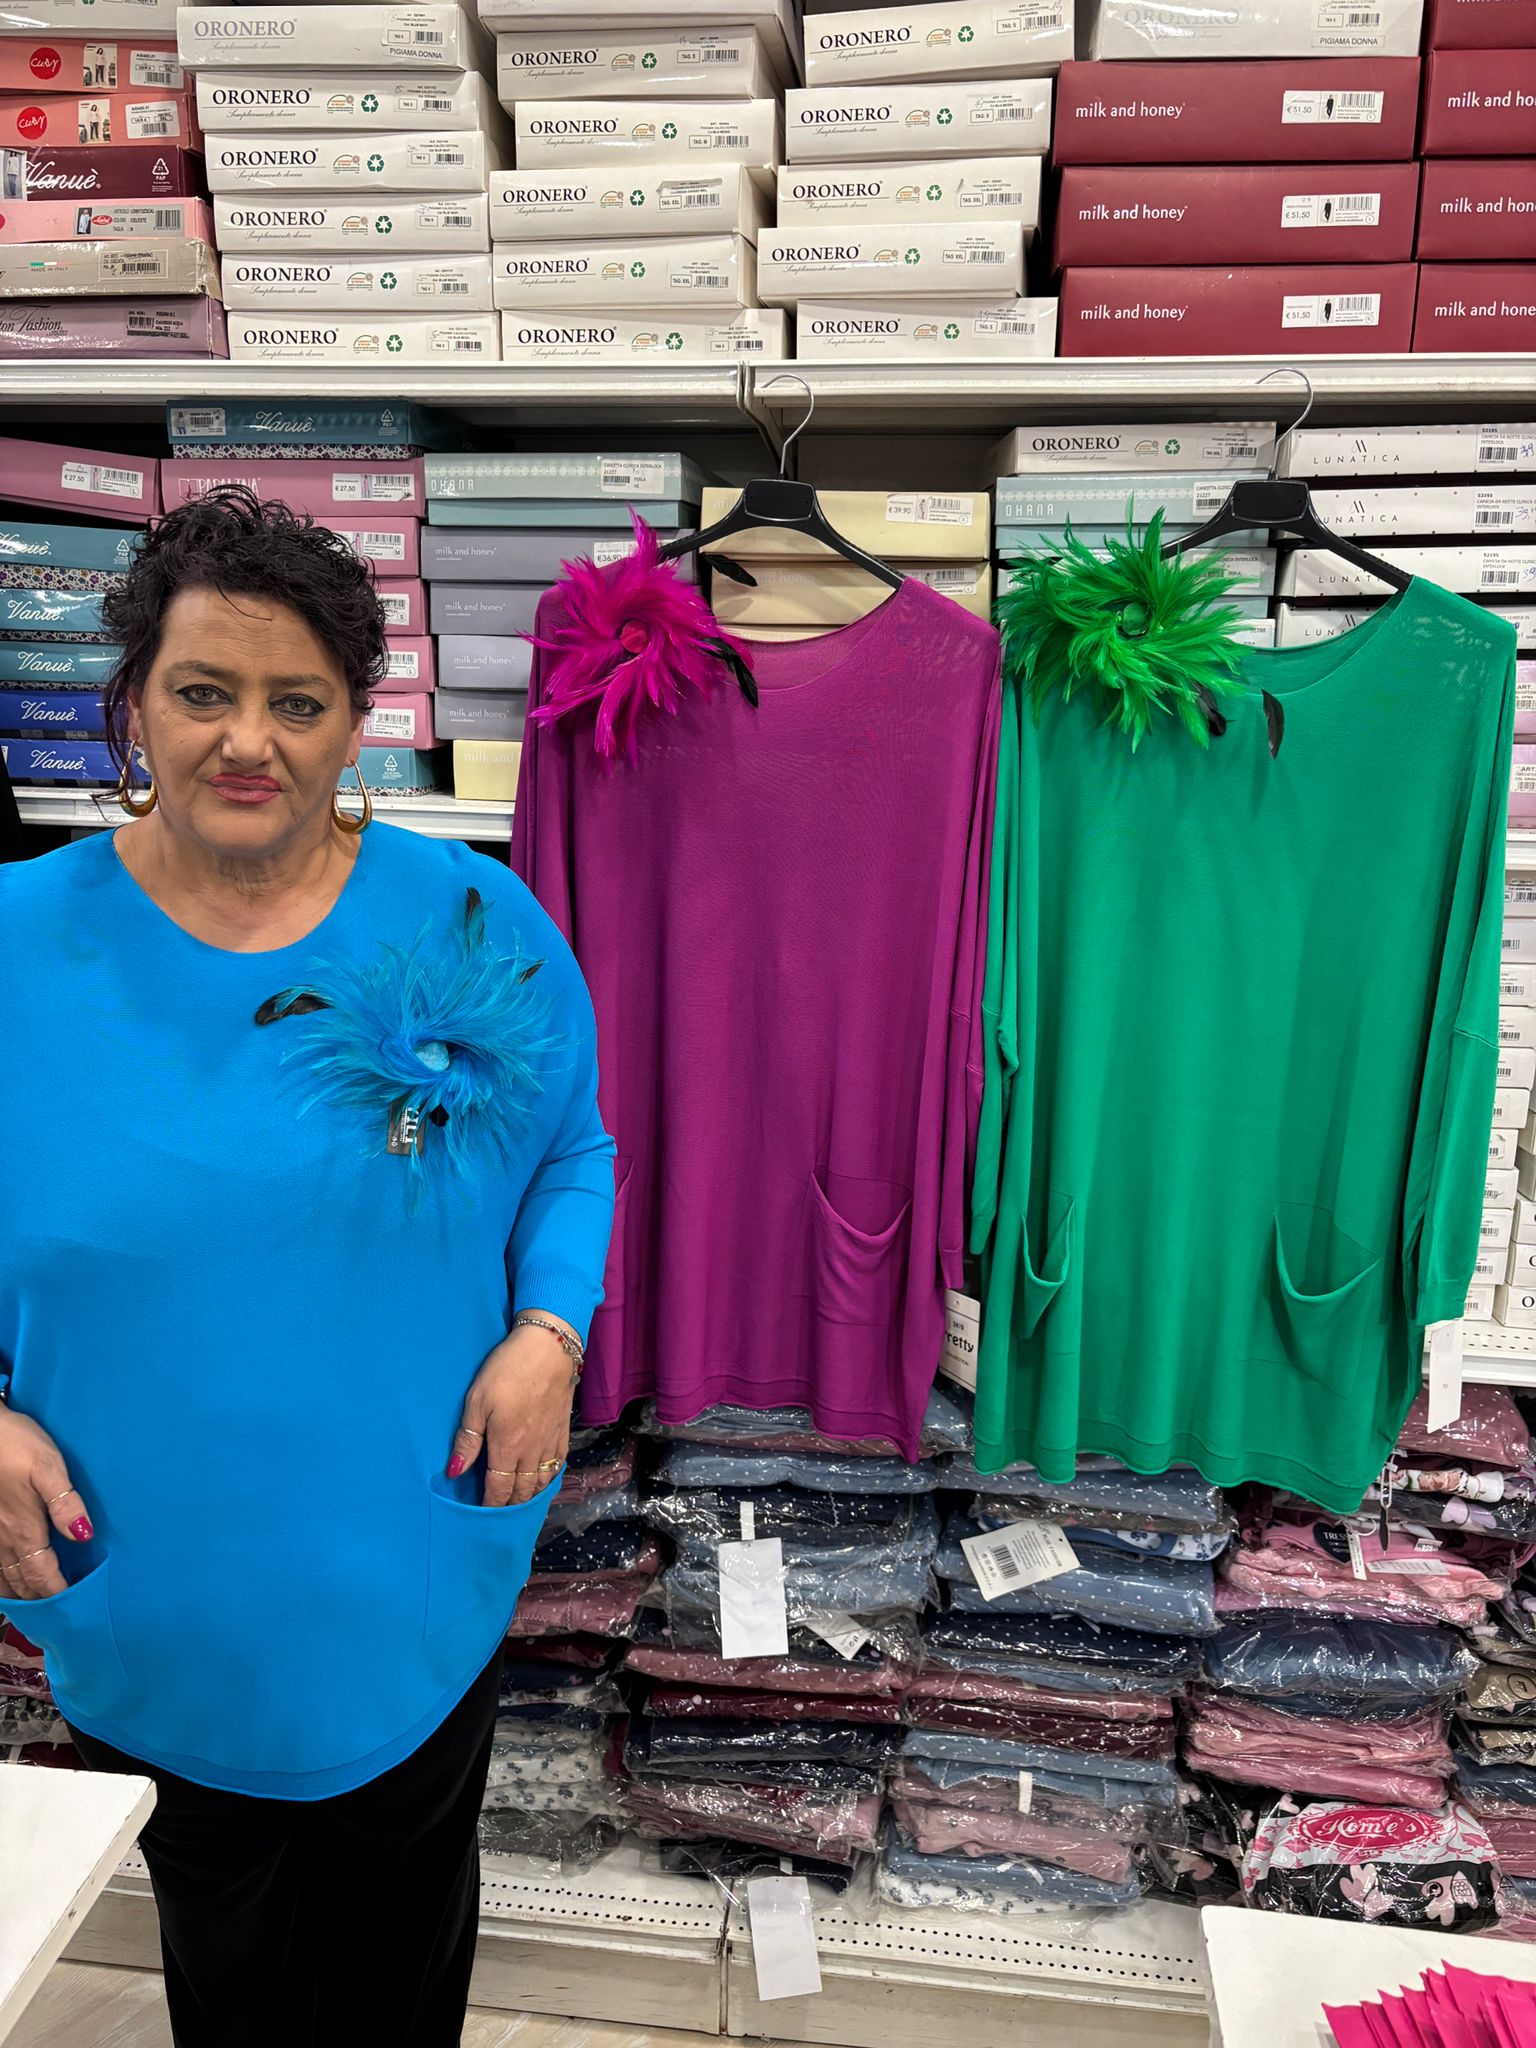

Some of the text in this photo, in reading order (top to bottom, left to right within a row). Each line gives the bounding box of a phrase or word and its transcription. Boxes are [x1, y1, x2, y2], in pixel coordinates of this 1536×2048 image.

[194, 20, 296, 38] ORONERO
[820, 27, 911, 50] ORONERO
[1320, 37, 1378, 45] PIGIAMA DONNA
[389, 47, 443, 59] PIGIAMA DONNA
[511, 50, 598, 66] ORONERO
[212, 89, 310, 105] ORONERO
[1447, 90, 1536, 108] milk and ho
[800, 107, 890, 125] ORONERO
[1075, 101, 1182, 121] milk and honey
[530, 119, 617, 135] ORONERO
[221, 150, 317, 167] ORONERO
[503, 187, 586, 204] ORONERO
[793, 182, 881, 199] ORONERO
[1079, 204, 1185, 222] milk and honey
[1440, 196, 1536, 214] milk and hon
[230, 211, 326, 227] ORONERO
[772, 246, 859, 262] ORONERO
[506, 258, 588, 274] ORONERO
[236, 267, 331, 282] ORONERO
[1080, 304, 1186, 323] milk and honey
[1434, 301, 1466, 318] milk
[1470, 300, 1497, 317] and
[518, 328, 615, 344] ORONERO
[811, 320, 899, 336] ORONERO
[244, 330, 338, 345] ORONERO
[256, 411, 313, 433] Vanuè
[1032, 437, 1120, 451] ORONERO
[1313, 454, 1400, 465] LUNATICA
[1006, 504, 1054, 517] OHANA
[1323, 514, 1398, 525] UNATICA
[435, 546, 495, 558] milk and honey
[445, 602, 504, 613] milk and honey
[17, 651, 73, 673] Vanuè
[453, 655, 512, 667] milk and honey
[21, 700, 77, 722] Vanuè
[449, 708, 508, 720] milk and honey
[30, 749, 84, 771] Vanuè
[464, 750, 514, 763] milk and
[944, 1331, 974, 1353] retty
